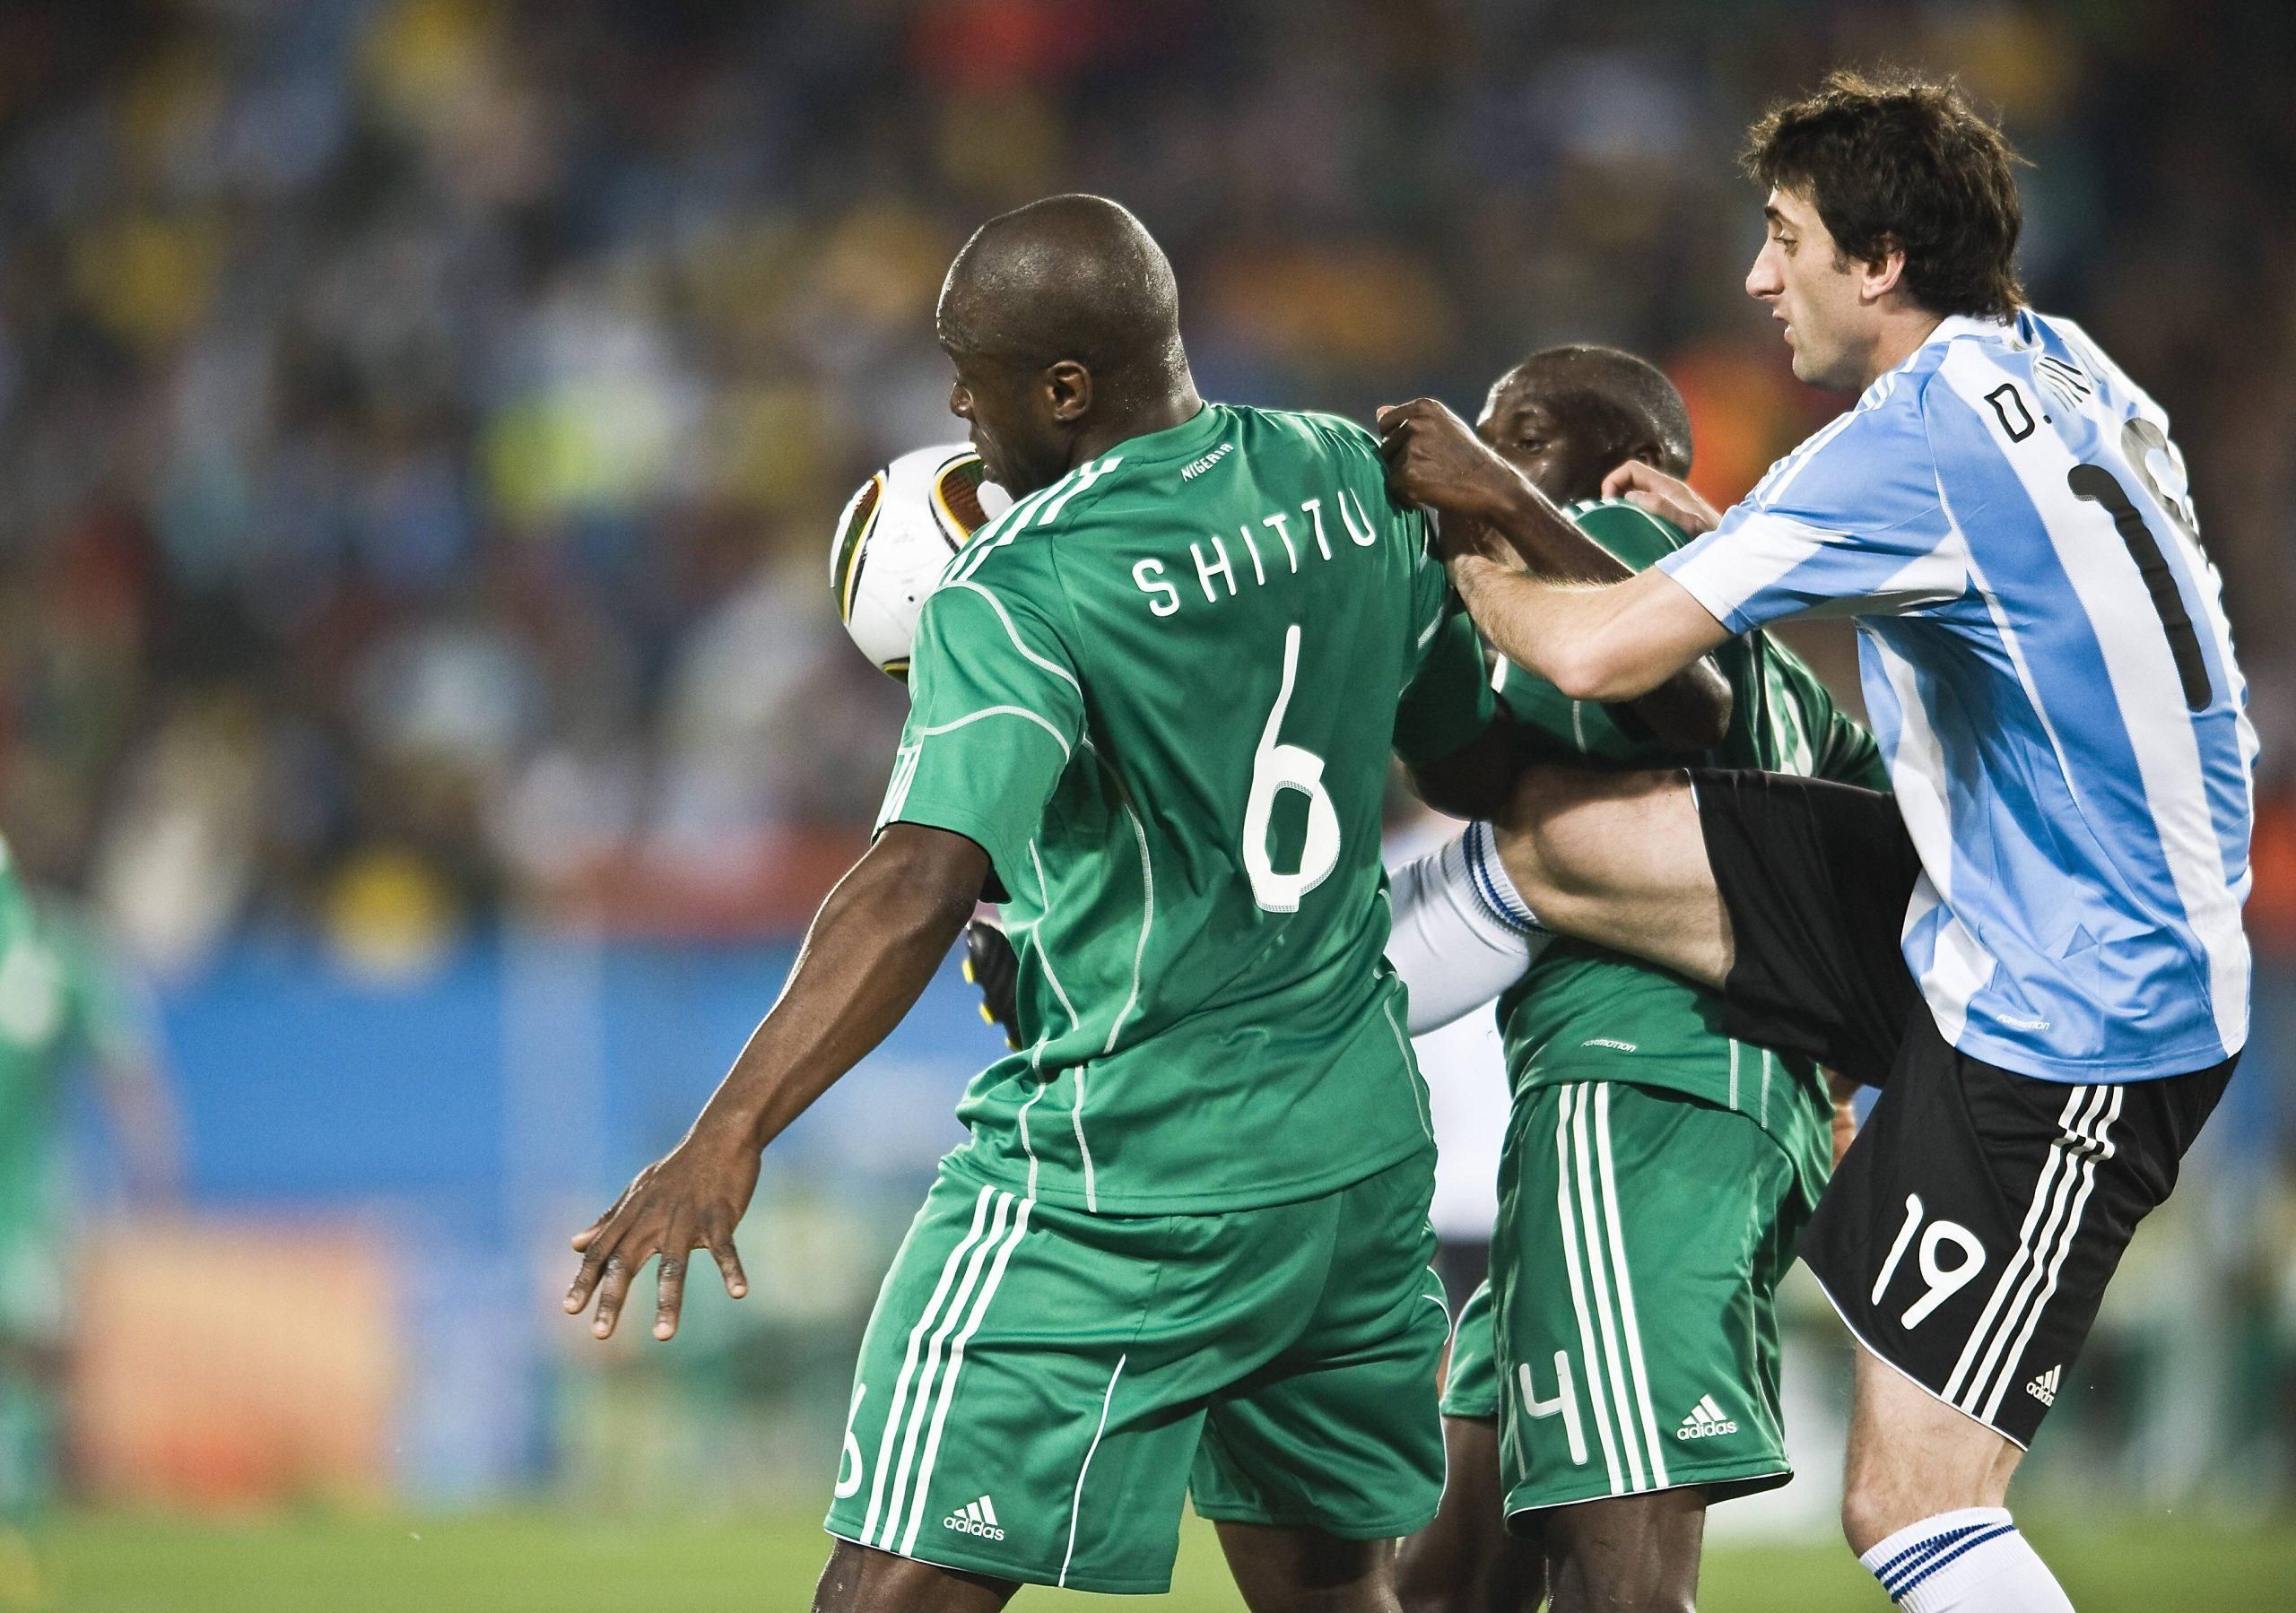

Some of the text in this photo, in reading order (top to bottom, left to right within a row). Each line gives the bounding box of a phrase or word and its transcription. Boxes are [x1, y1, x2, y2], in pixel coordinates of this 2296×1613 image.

[1984, 383, 2052, 443] D.
[1180, 443, 1234, 482] NIGERIA
[1131, 486, 1376, 617] SHITTU
[1242, 625, 1341, 913] 6
[1871, 1192, 1986, 1331] 19
[834, 1383, 867, 1498] 6
[1676, 1421, 1737, 1441] adidas
[943, 1515, 1005, 1541] adidas
